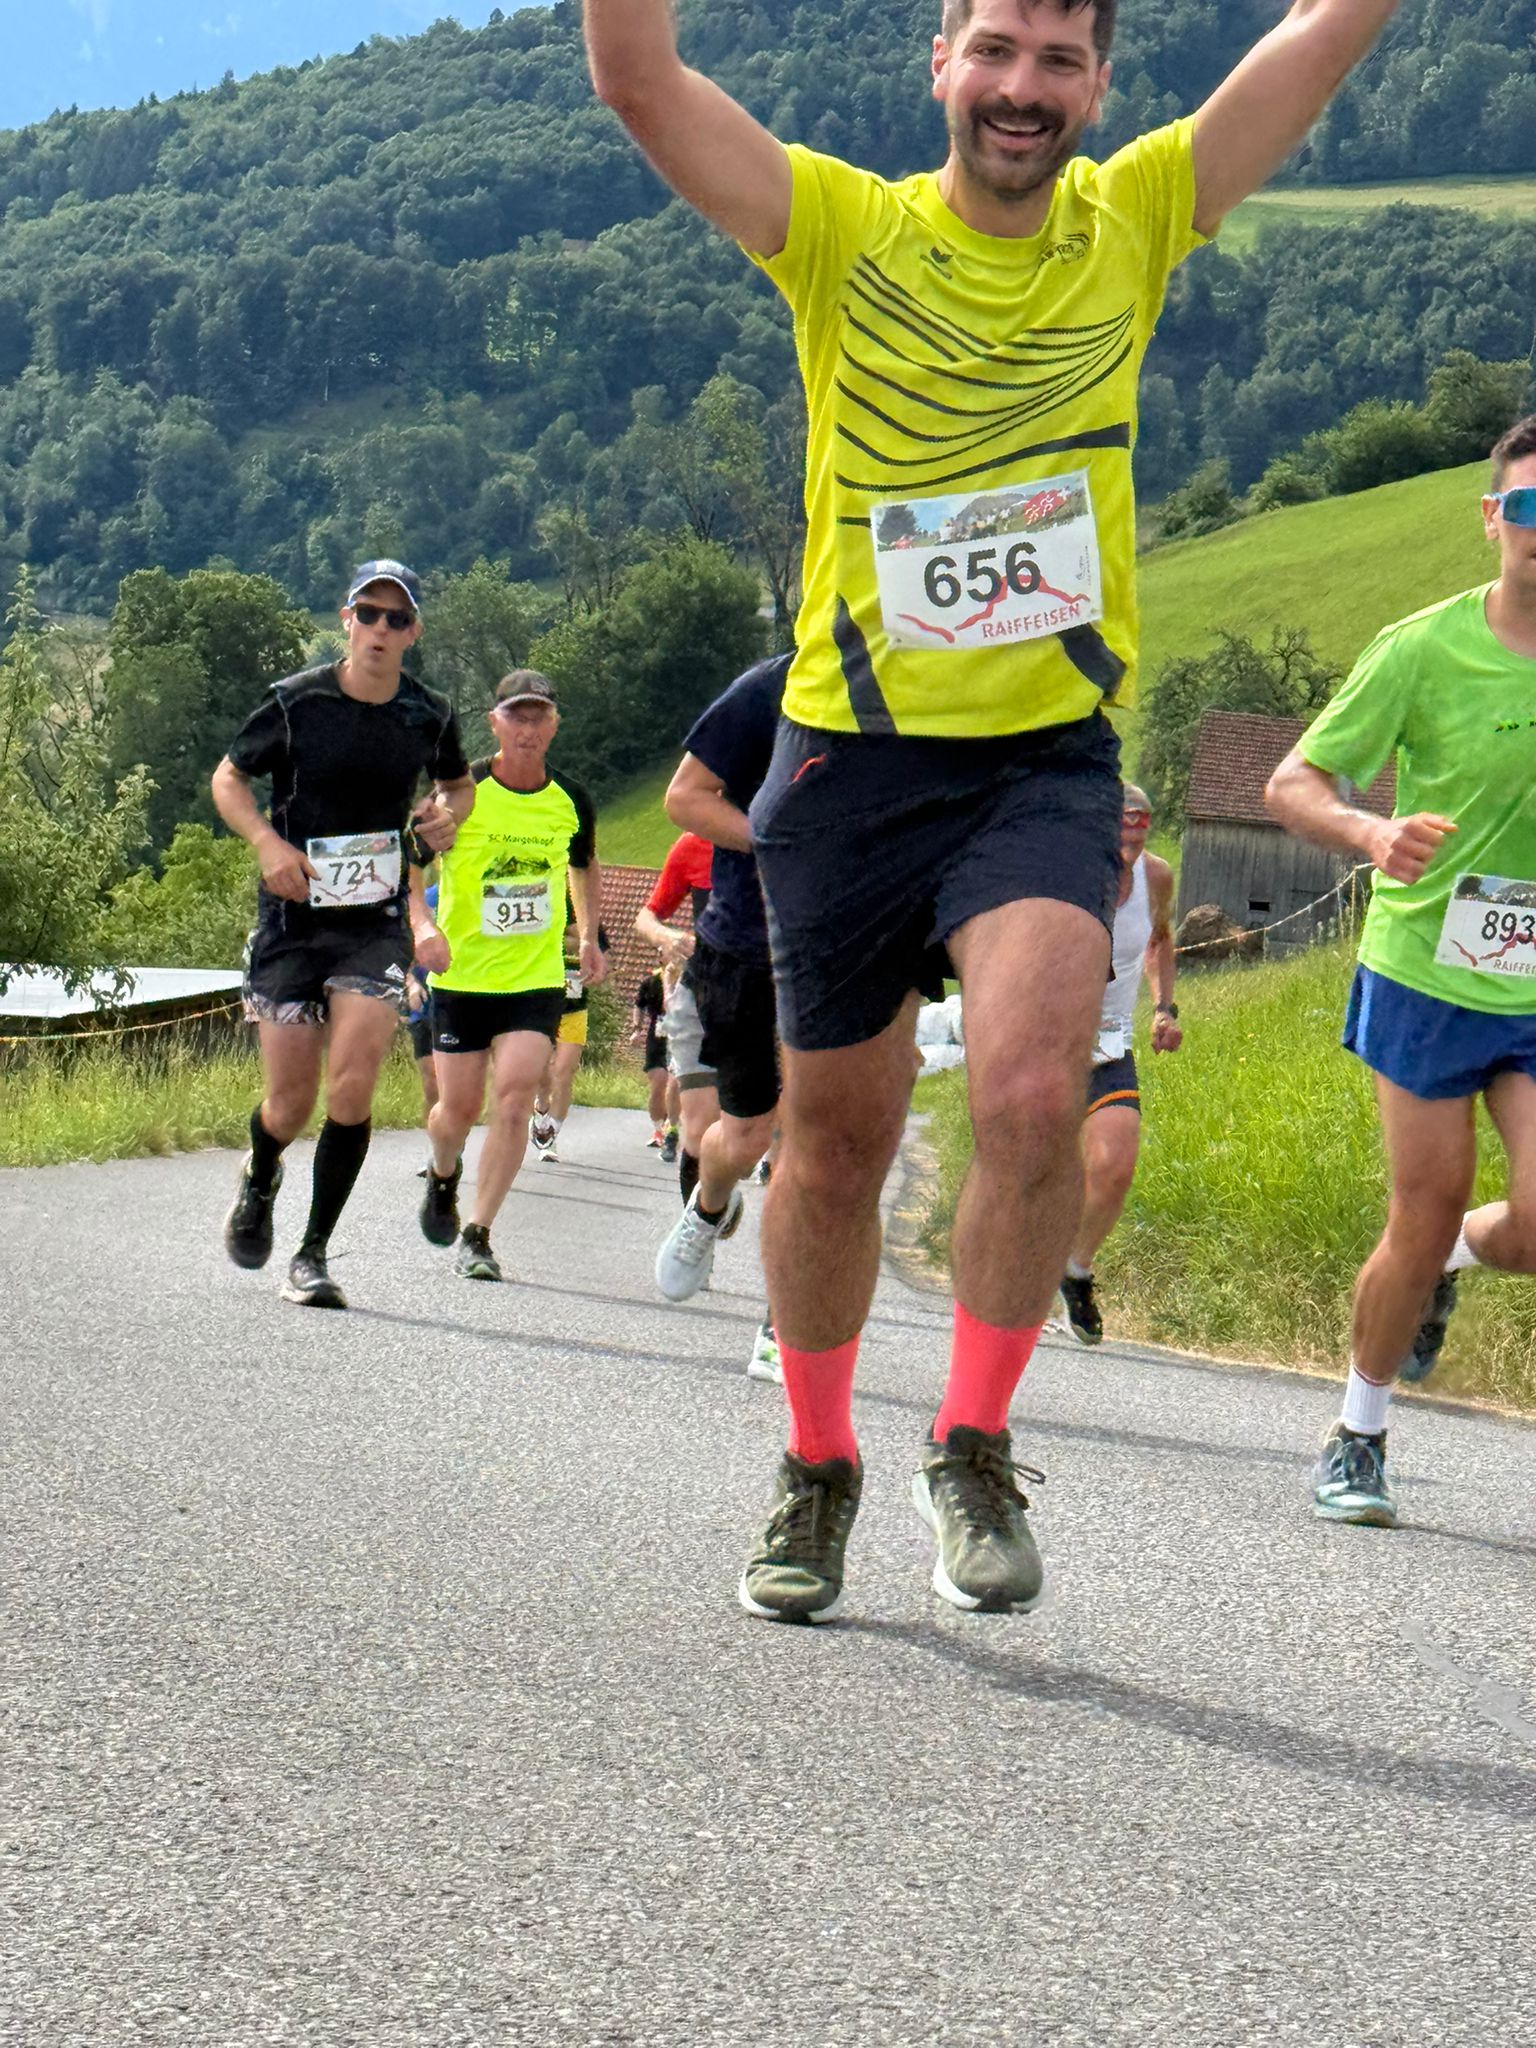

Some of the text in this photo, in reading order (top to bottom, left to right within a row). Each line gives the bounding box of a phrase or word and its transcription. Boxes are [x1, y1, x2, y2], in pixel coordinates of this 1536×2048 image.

[924, 542, 1041, 608] 656
[982, 603, 1080, 638] RAIFFEISEN
[328, 859, 375, 886] 721
[497, 902, 534, 924] 911
[1481, 910, 1535, 944] 893
